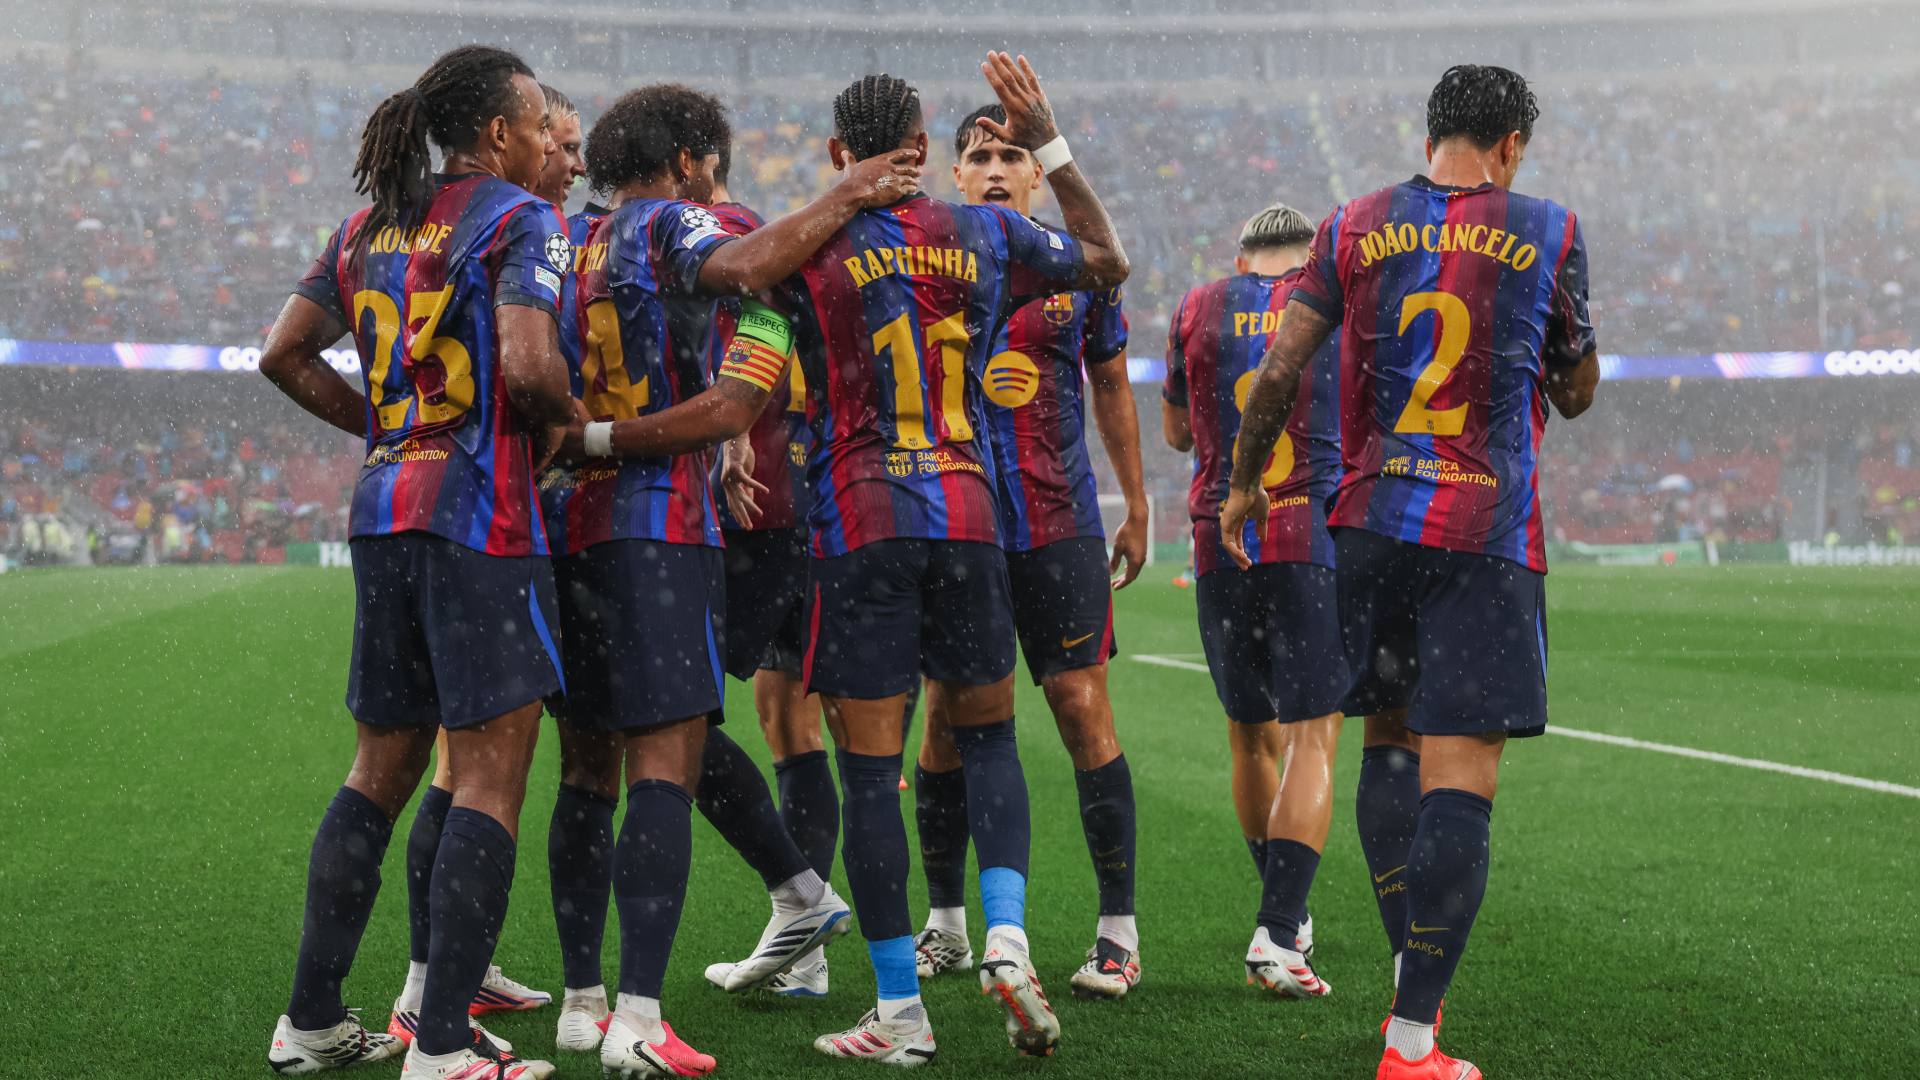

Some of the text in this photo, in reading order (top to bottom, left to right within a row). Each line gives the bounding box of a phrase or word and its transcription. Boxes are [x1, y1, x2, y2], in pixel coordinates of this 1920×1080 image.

[1357, 222, 1536, 272] JOÃO CANCELO
[843, 245, 978, 288] RAPHINHA
[748, 314, 788, 335] RESPECT
[1233, 308, 1285, 337] PED
[353, 283, 475, 430] 23
[1393, 291, 1471, 436] 2
[872, 310, 973, 450] 11
[385, 449, 449, 463] FOUNDATION
[916, 451, 952, 464] BARÇA
[1416, 459, 1459, 473] BARÇA
[917, 462, 985, 475] FOUNDATION
[1415, 469, 1497, 488] FOUNDATION
[1378, 881, 1407, 898] BARÇ
[1407, 938, 1444, 957] BARÇA
